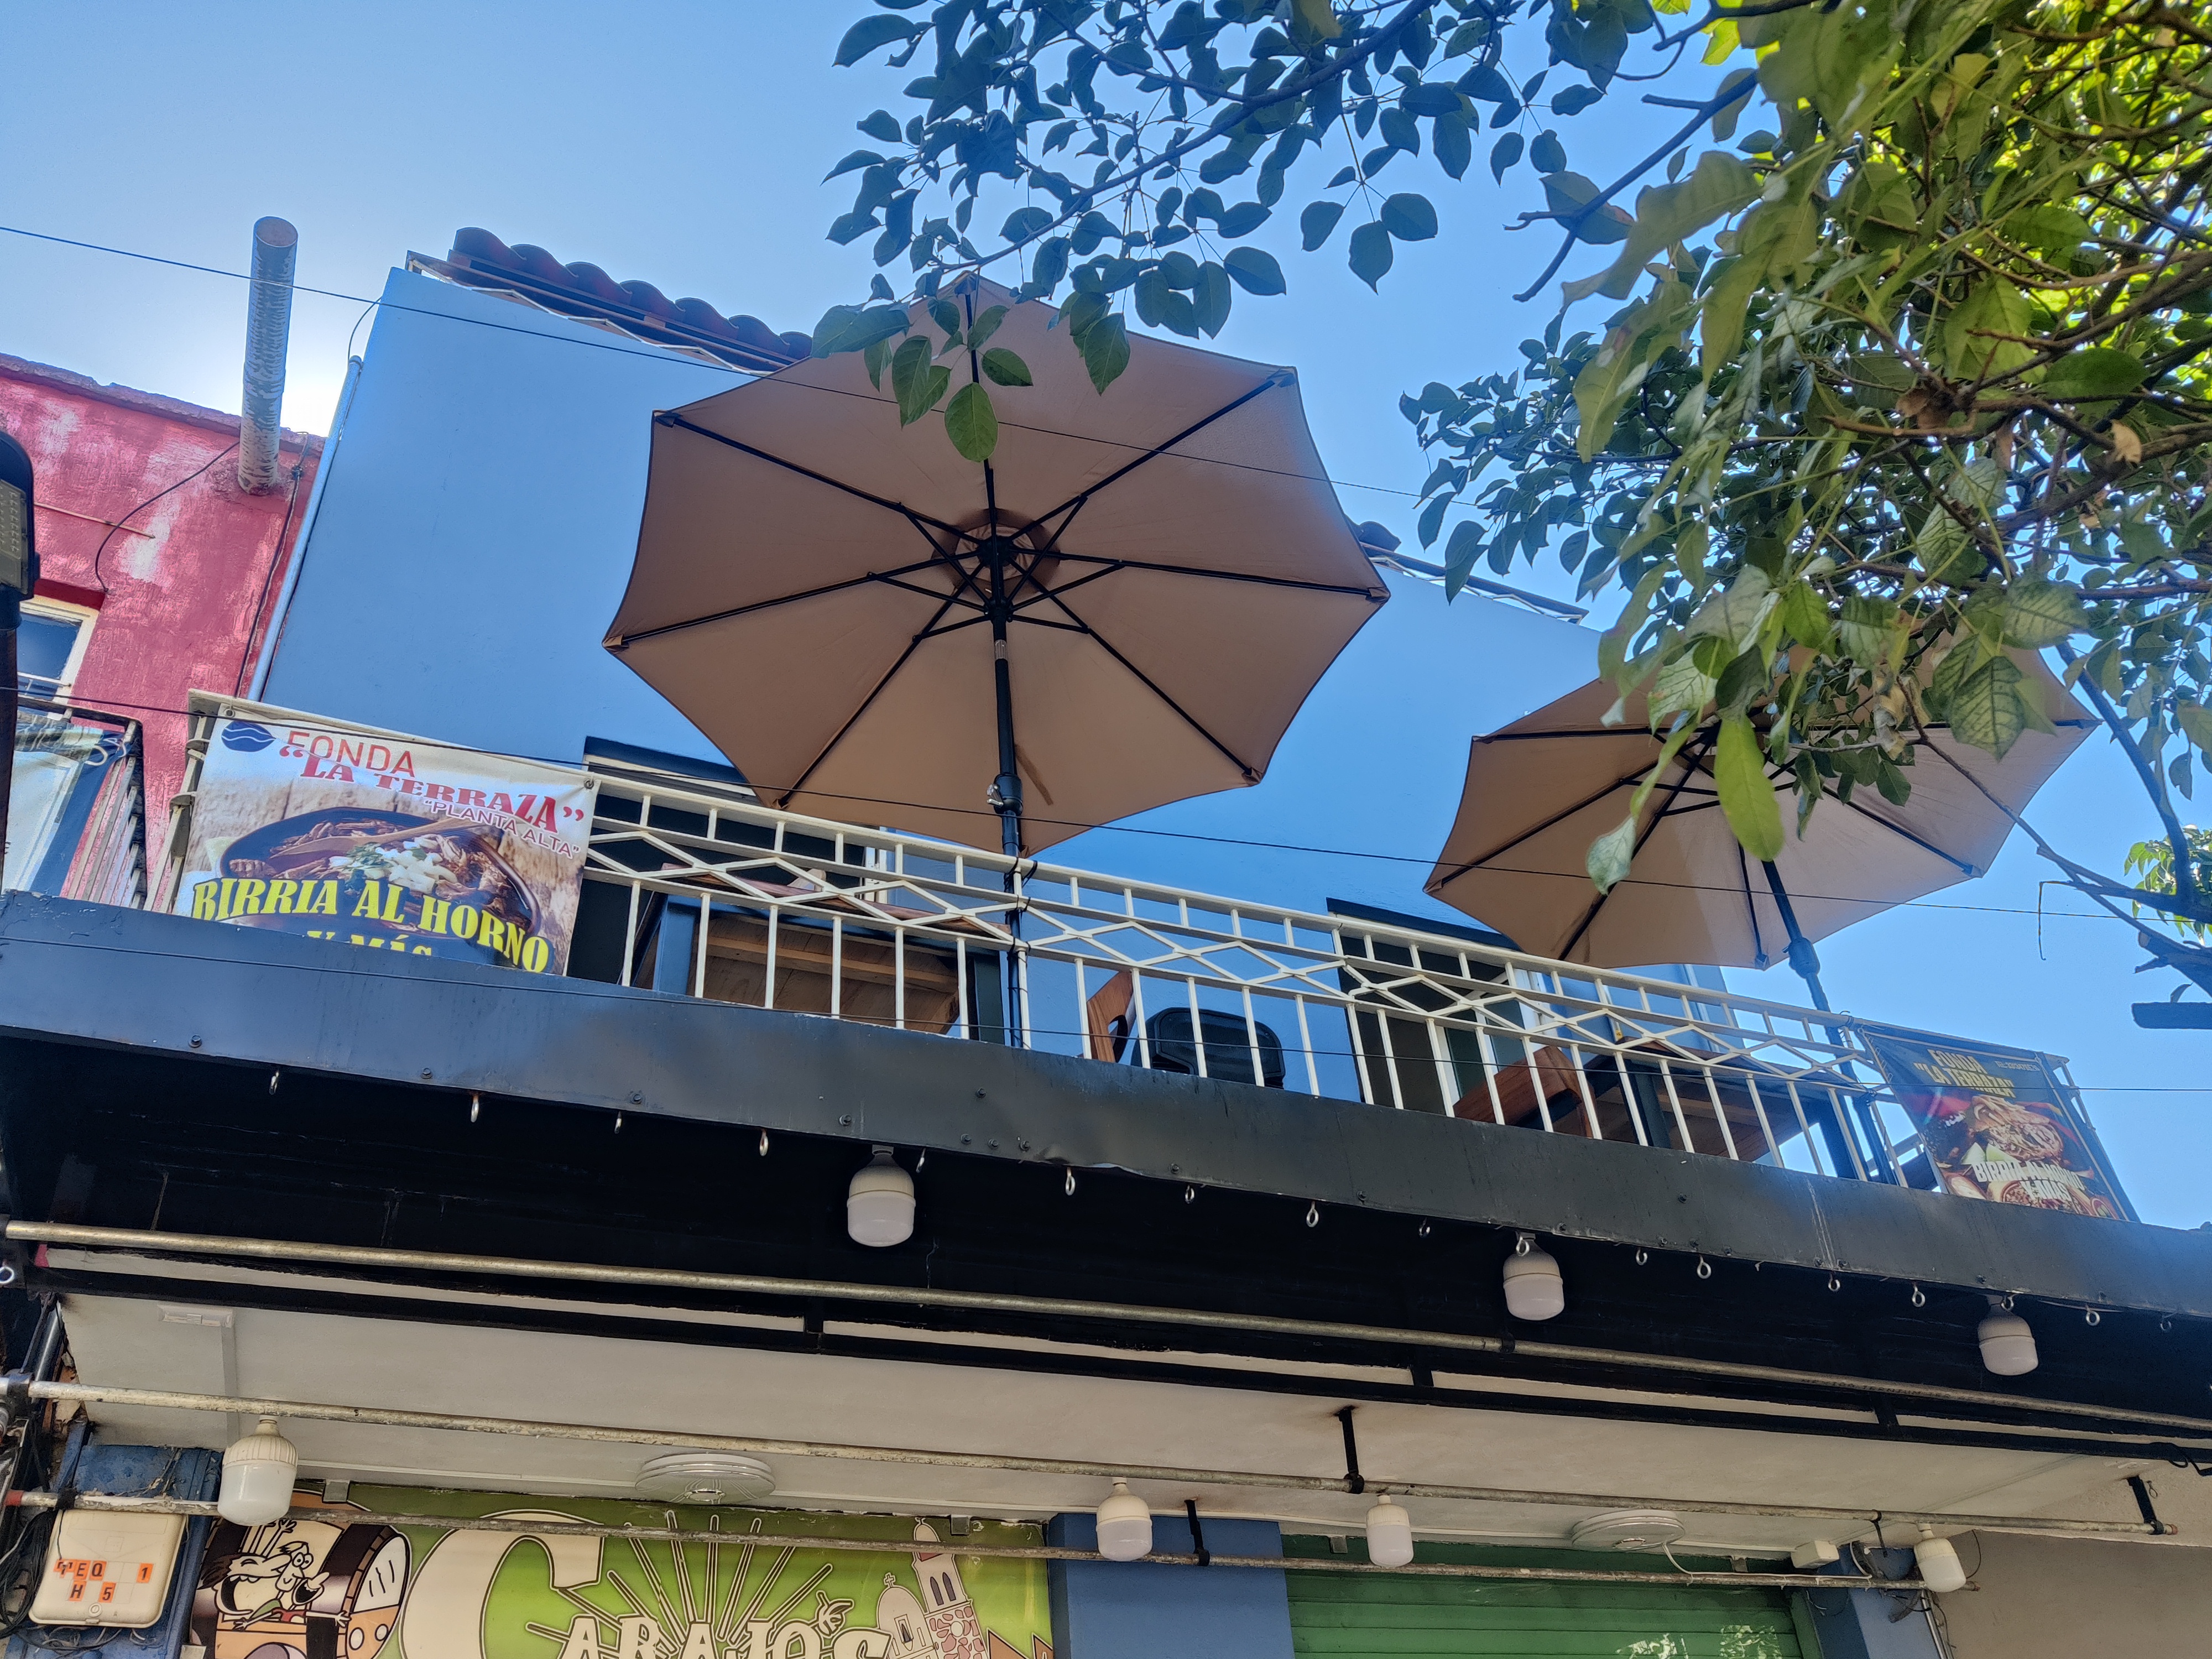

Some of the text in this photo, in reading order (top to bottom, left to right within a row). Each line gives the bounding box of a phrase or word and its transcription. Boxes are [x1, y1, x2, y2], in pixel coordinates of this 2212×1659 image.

[287, 731, 415, 778] FONDA
[192, 878, 337, 921] BIRRIA
[352, 880, 404, 923] AL
[418, 894, 549, 973] HORNO
[1927, 1049, 1988, 1074] FONDA
[1972, 1161, 2085, 1191] BIRRIA AL HORNO
[2020, 1181, 2037, 1201] Y
[140, 1567, 149, 1580] 1
[70, 1584, 113, 1601] H 5
